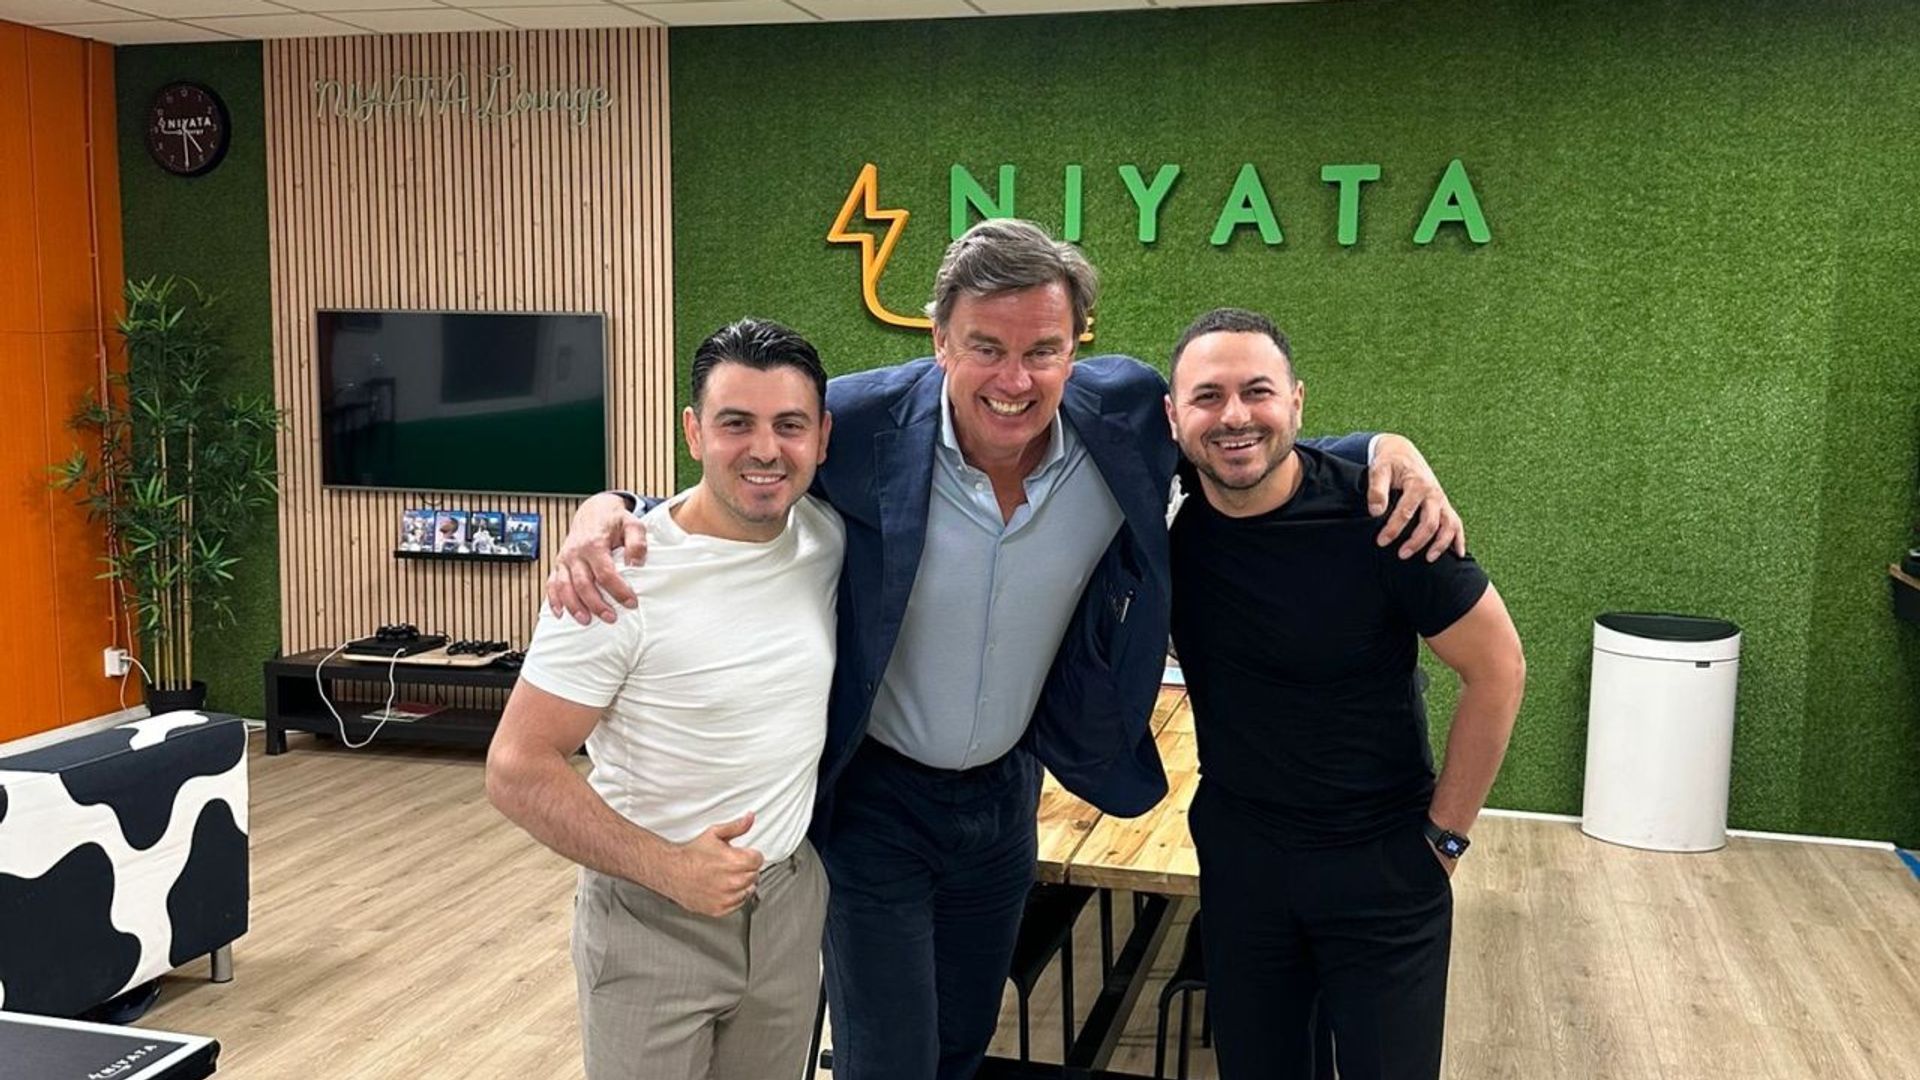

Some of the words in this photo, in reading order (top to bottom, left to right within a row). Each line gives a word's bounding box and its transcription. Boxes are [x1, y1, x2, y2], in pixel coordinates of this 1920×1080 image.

[167, 116, 212, 129] NIYATA
[315, 72, 470, 122] NIYATA
[475, 64, 614, 127] Lounge
[951, 159, 1492, 246] NIYATA
